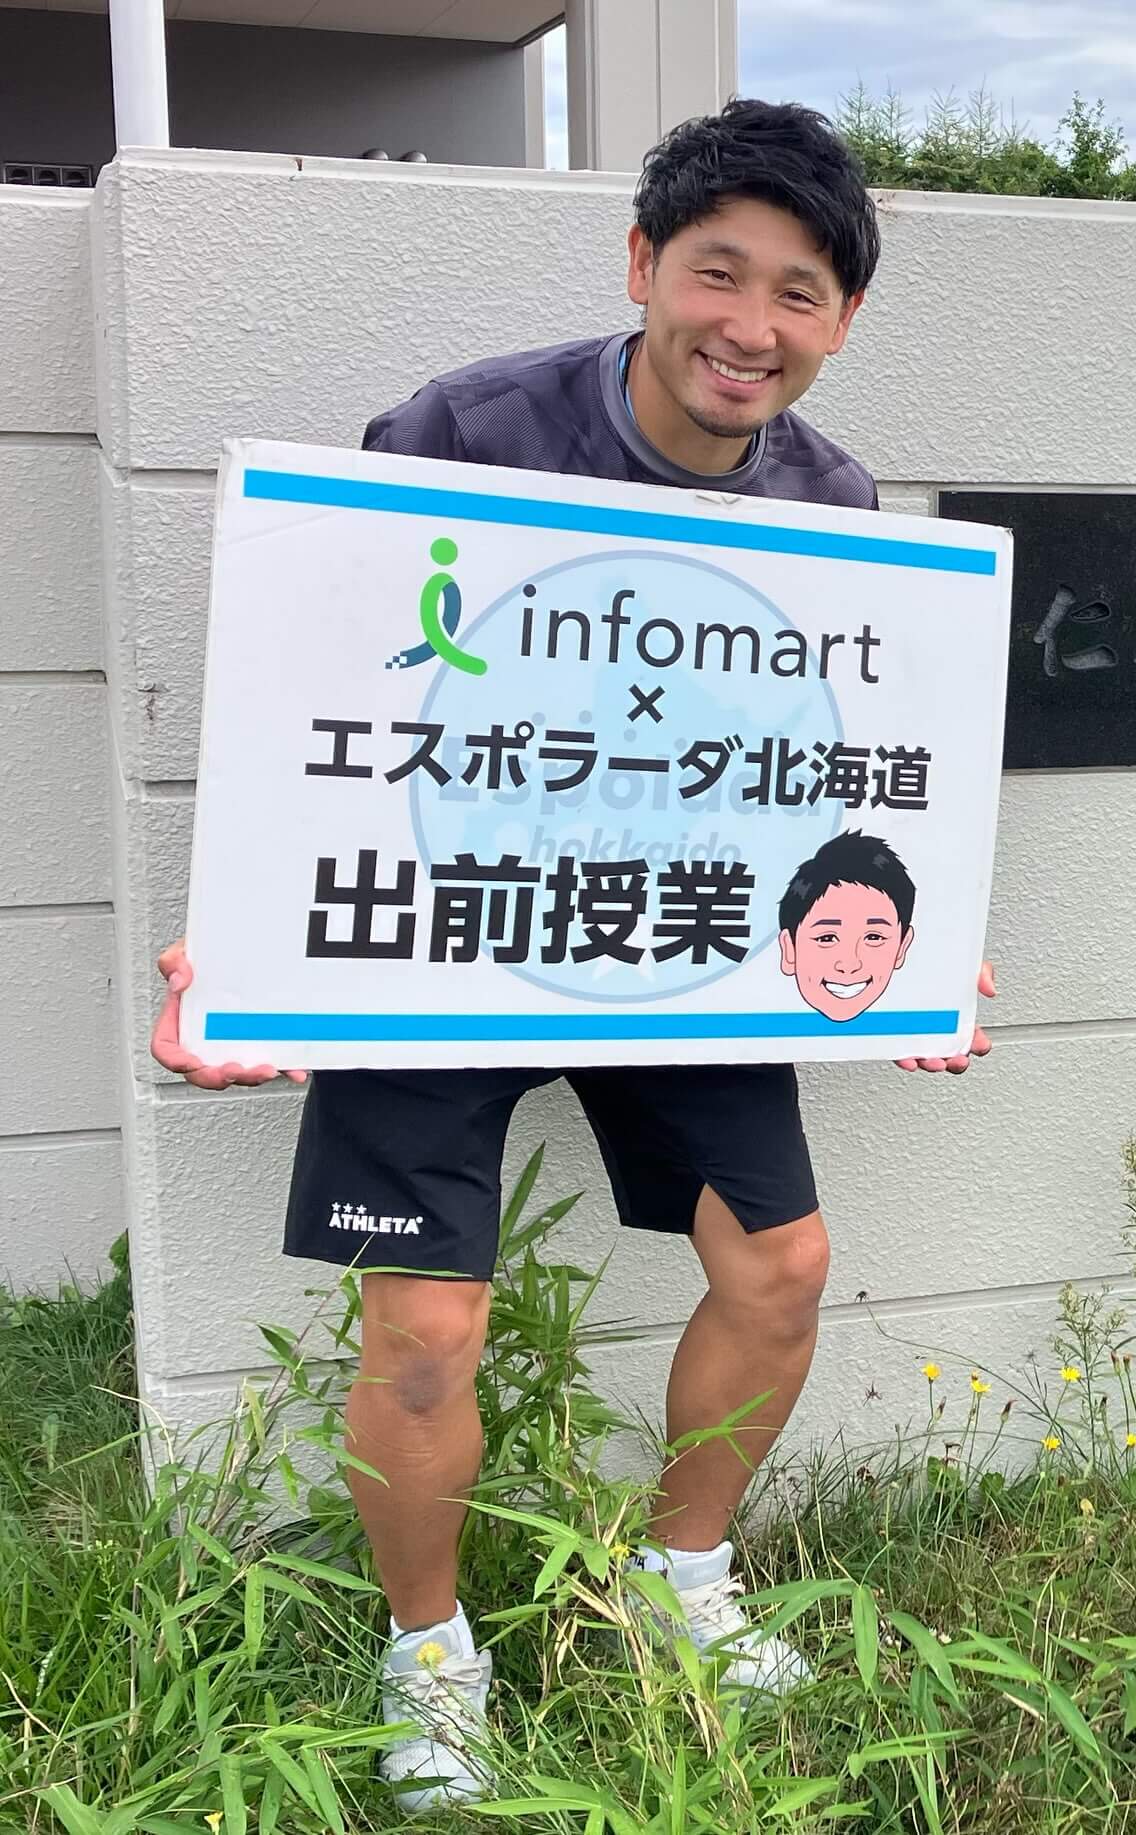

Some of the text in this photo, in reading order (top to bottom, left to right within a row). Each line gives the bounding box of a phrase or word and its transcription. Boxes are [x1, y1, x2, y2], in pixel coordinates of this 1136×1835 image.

[521, 583, 881, 684] infomart
[304, 717, 932, 812] エスポラーダ北海道
[305, 848, 756, 965] 出前授業
[328, 1212, 420, 1235] ATHLETA
